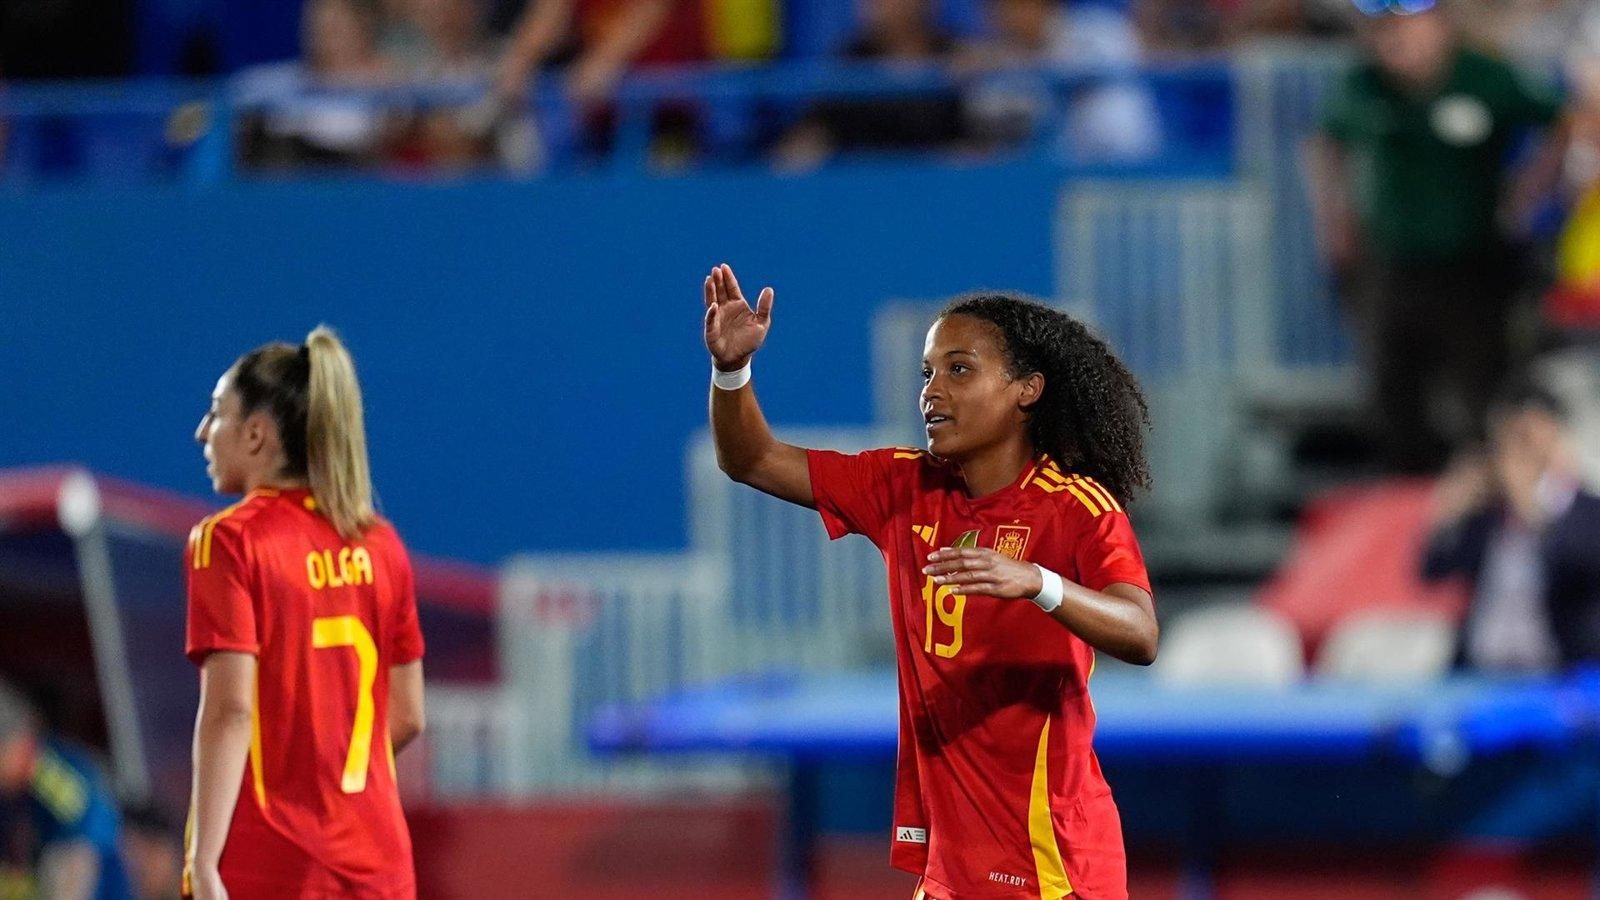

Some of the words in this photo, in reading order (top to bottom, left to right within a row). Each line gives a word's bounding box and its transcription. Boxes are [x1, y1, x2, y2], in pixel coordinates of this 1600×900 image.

[307, 546, 373, 590] OLGA
[922, 575, 967, 659] 19
[312, 615, 378, 794] 7
[989, 871, 1026, 887] HEAT.RDY
